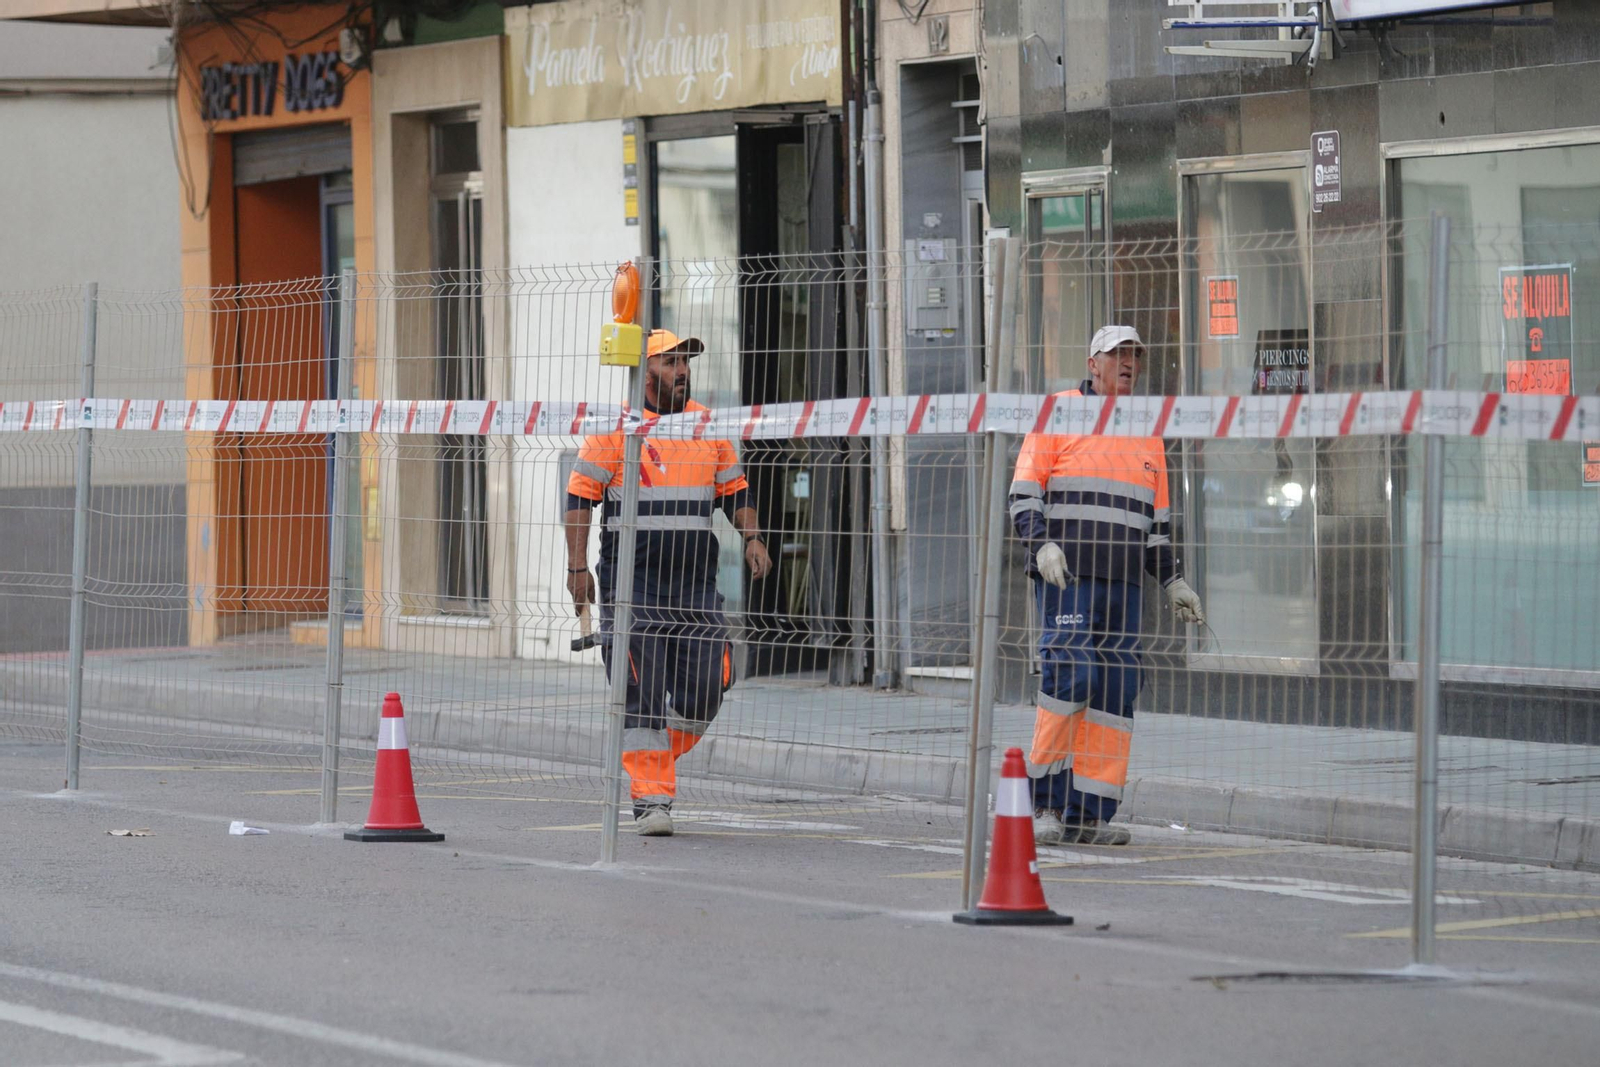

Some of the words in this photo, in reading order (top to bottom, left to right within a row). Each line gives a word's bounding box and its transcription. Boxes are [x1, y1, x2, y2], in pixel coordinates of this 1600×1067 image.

[200, 62, 278, 120] PRETTY
[284, 52, 343, 112] DOGS
[523, 13, 603, 96] Pamela
[1503, 276, 1518, 319] SE
[1521, 274, 1569, 323] ALQUILA
